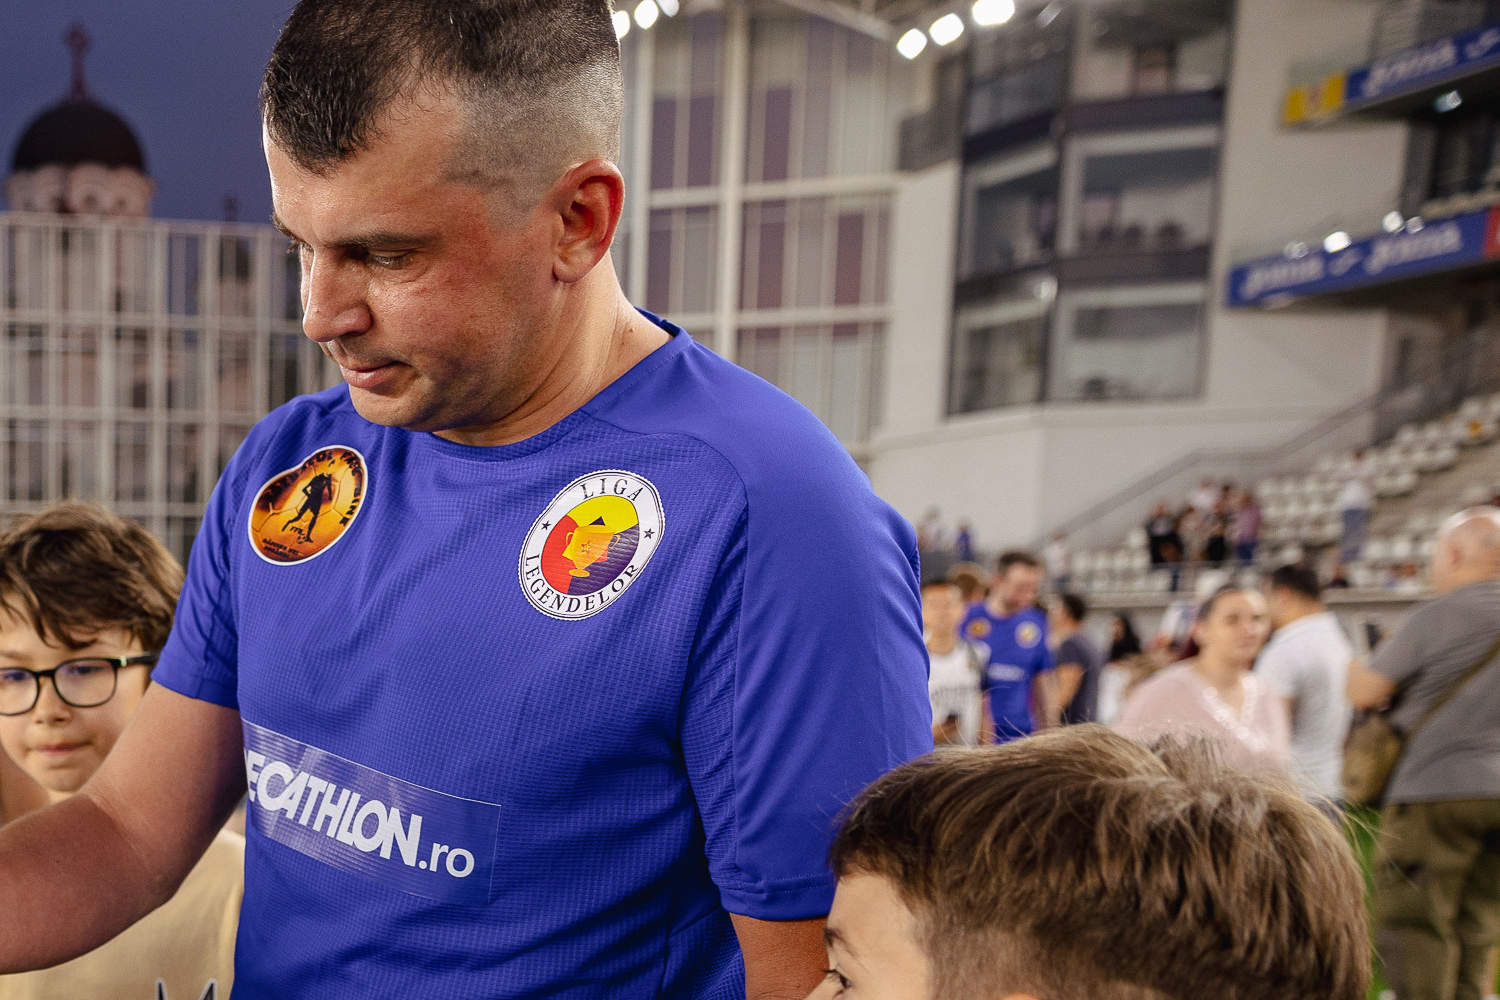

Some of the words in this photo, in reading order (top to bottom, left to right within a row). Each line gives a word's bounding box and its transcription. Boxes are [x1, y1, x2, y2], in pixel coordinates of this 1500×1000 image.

[581, 478, 643, 501] LIGA
[525, 554, 639, 613] LEGENDELOR
[244, 747, 475, 878] ECATHLON.ro
